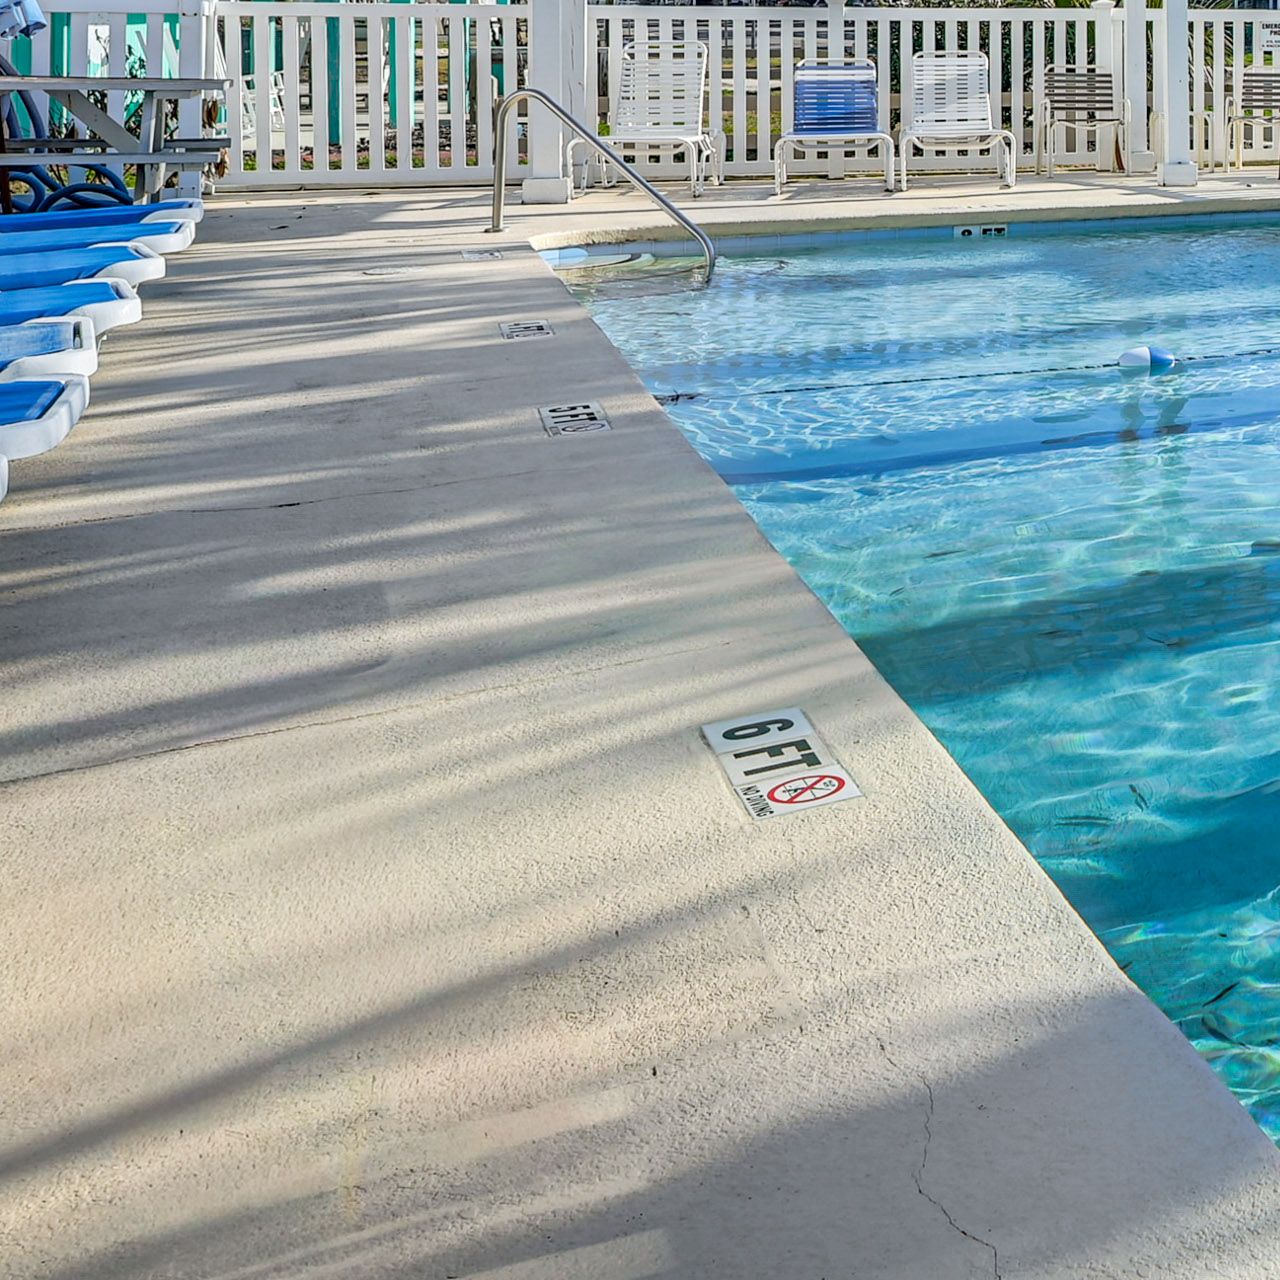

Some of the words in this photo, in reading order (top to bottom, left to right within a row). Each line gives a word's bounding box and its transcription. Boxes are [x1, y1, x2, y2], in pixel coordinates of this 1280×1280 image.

[548, 404, 590, 413] 5
[551, 412, 598, 424] FT
[722, 718, 794, 741] 6
[733, 738, 822, 776] FT
[740, 785, 760, 796] NO
[746, 795, 775, 817] DIVING
